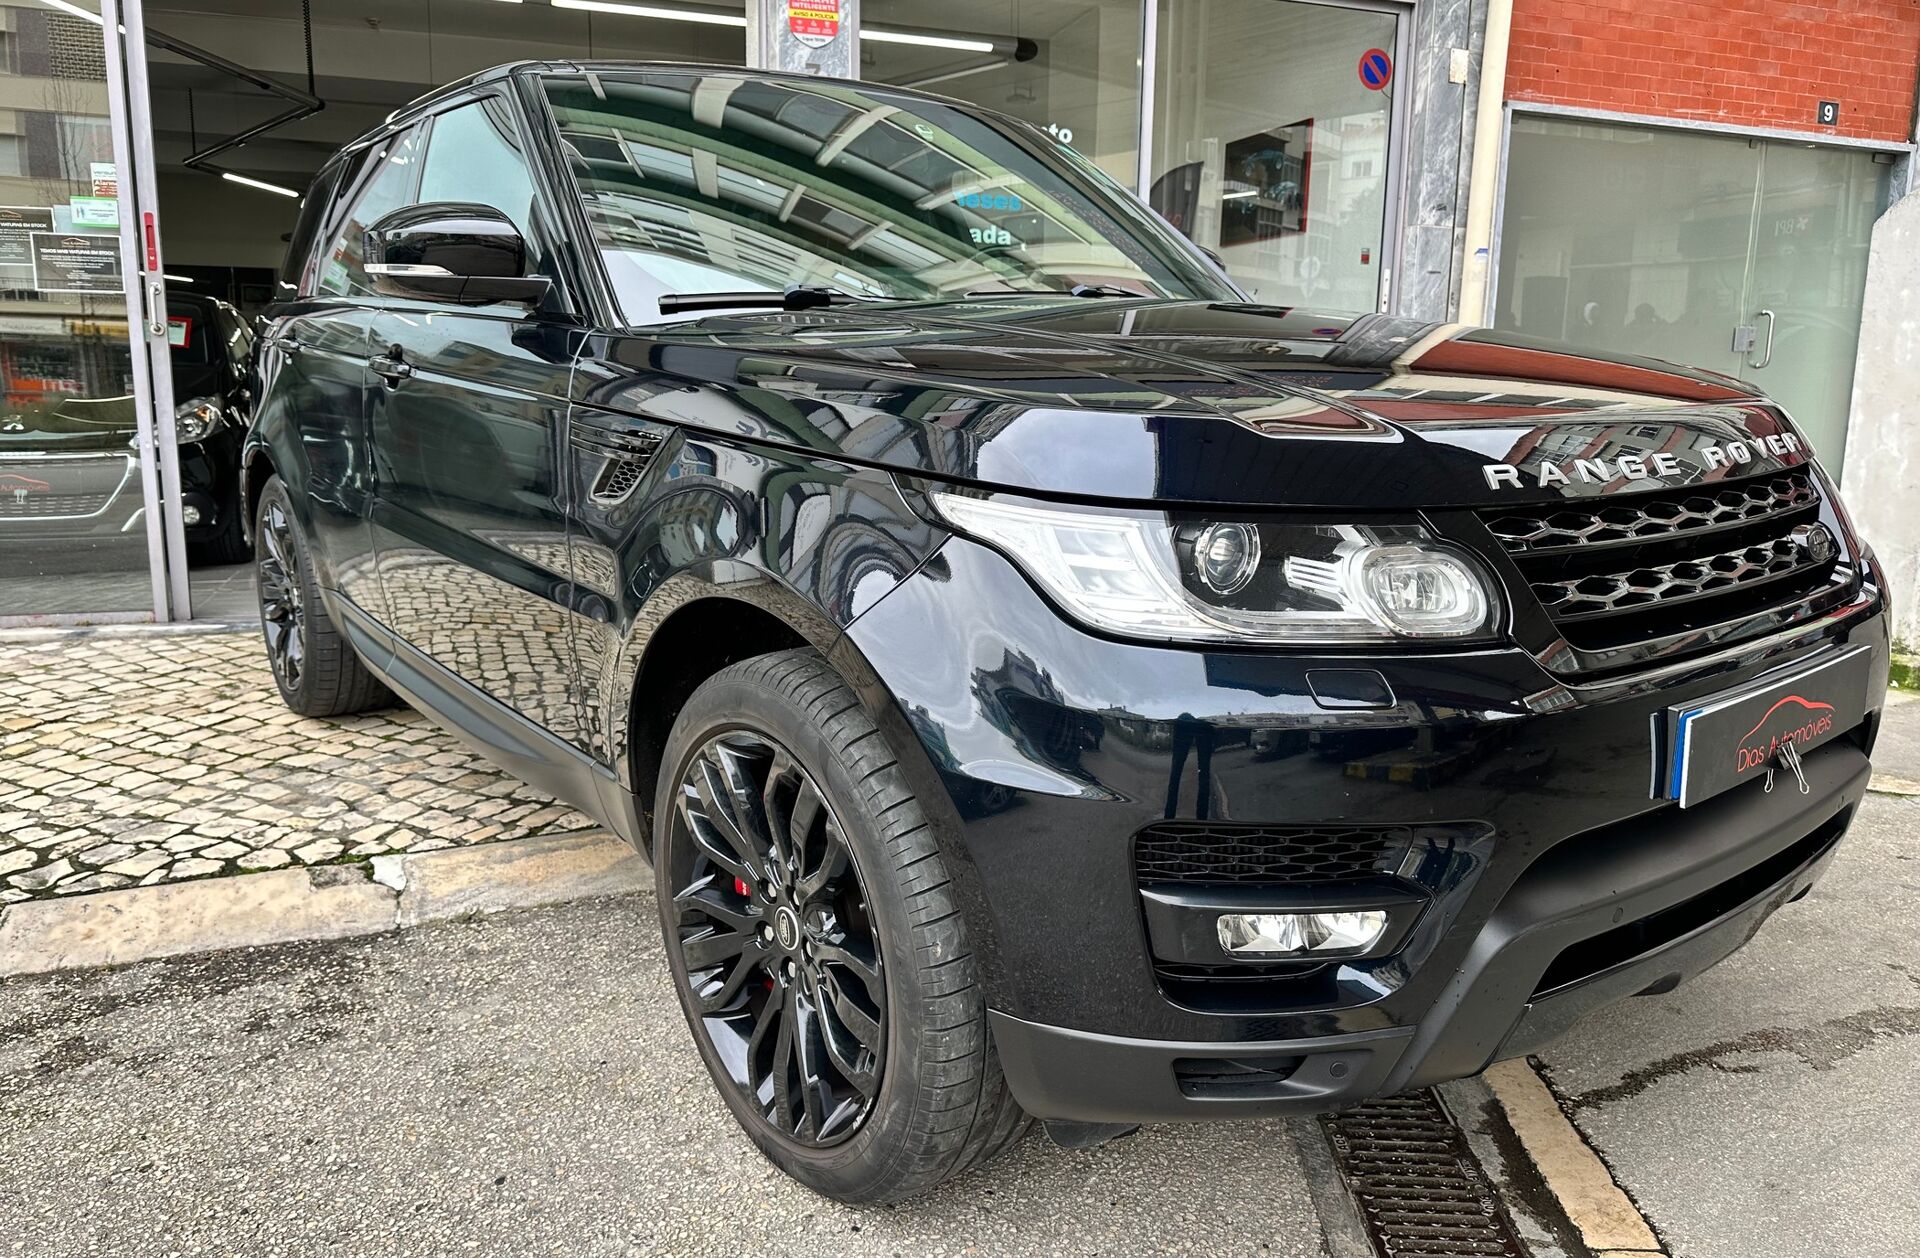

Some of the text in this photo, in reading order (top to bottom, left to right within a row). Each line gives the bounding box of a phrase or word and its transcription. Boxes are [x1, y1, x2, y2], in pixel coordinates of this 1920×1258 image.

[791, 1, 836, 11] INTELIGENTE
[1823, 104, 1833, 122] 9
[1041, 122, 1073, 144] to
[1482, 432, 1802, 491] RANGE ROVER
[1737, 745, 1765, 773] Dias
